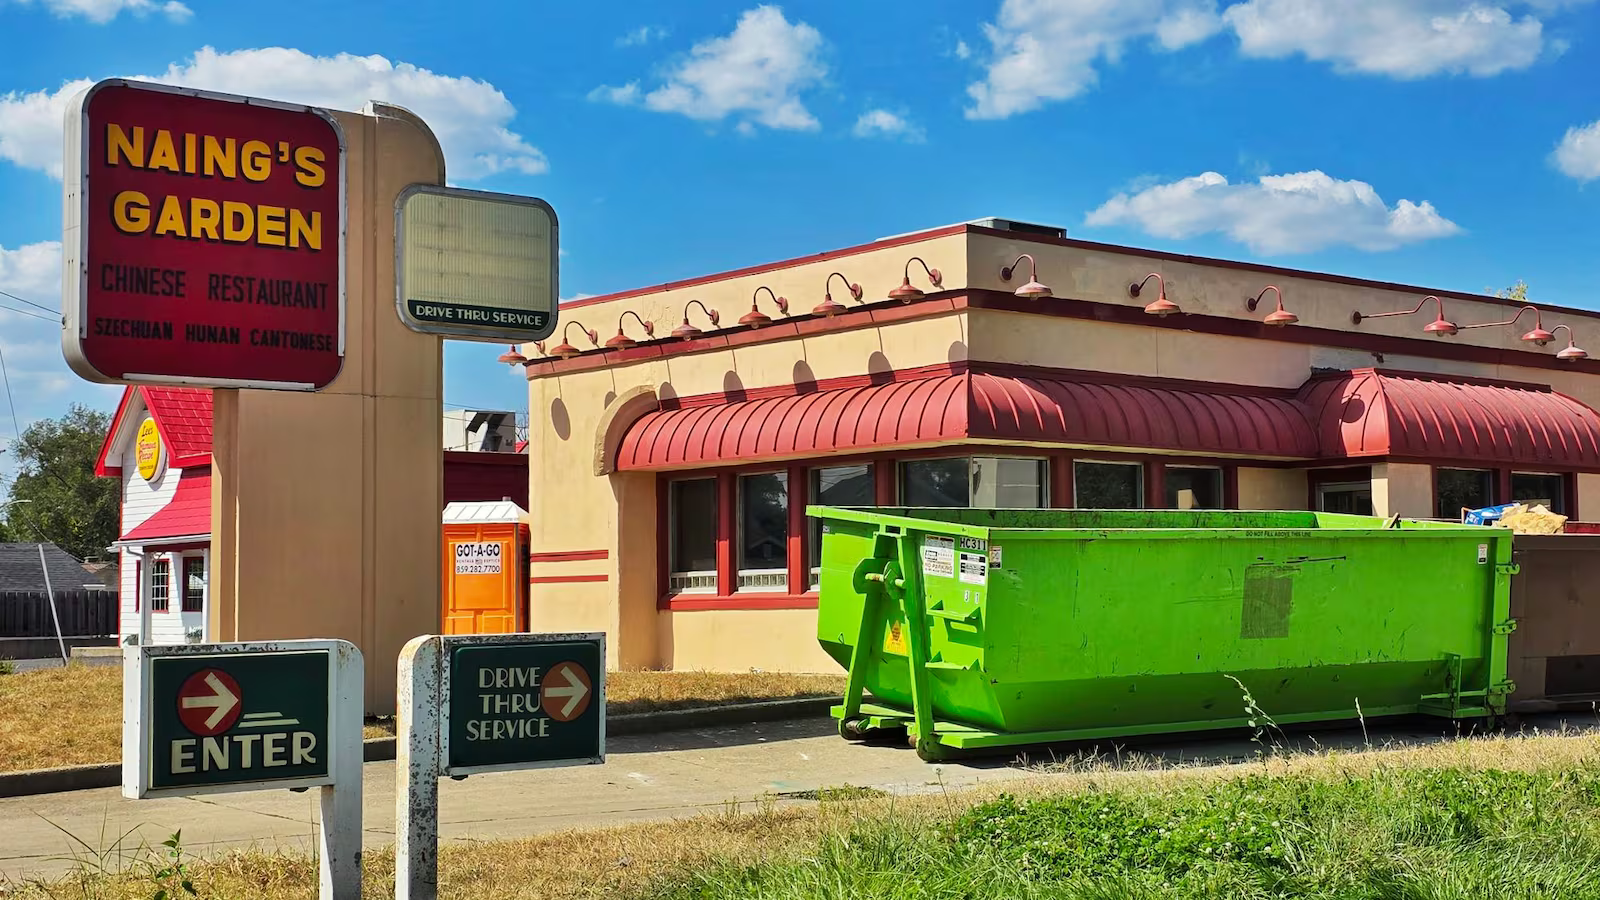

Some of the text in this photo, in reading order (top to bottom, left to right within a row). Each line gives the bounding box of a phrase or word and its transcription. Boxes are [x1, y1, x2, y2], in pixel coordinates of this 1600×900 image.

[106, 123, 326, 188] NAING'S
[112, 190, 322, 250] GARDEN
[100, 263, 328, 311] CHINESE RESTAURANT
[415, 305, 542, 326] DRIVE THRU SERVICE
[94, 317, 332, 352] SZECHUAN HUNAN CANTONESE
[960, 537, 986, 551] HC311
[456, 565, 500, 573] 859.282.7700
[478, 666, 541, 689] DRIVE
[478, 693, 541, 714] THRU
[466, 717, 550, 741] SERVICE
[171, 731, 317, 774] ENTER
